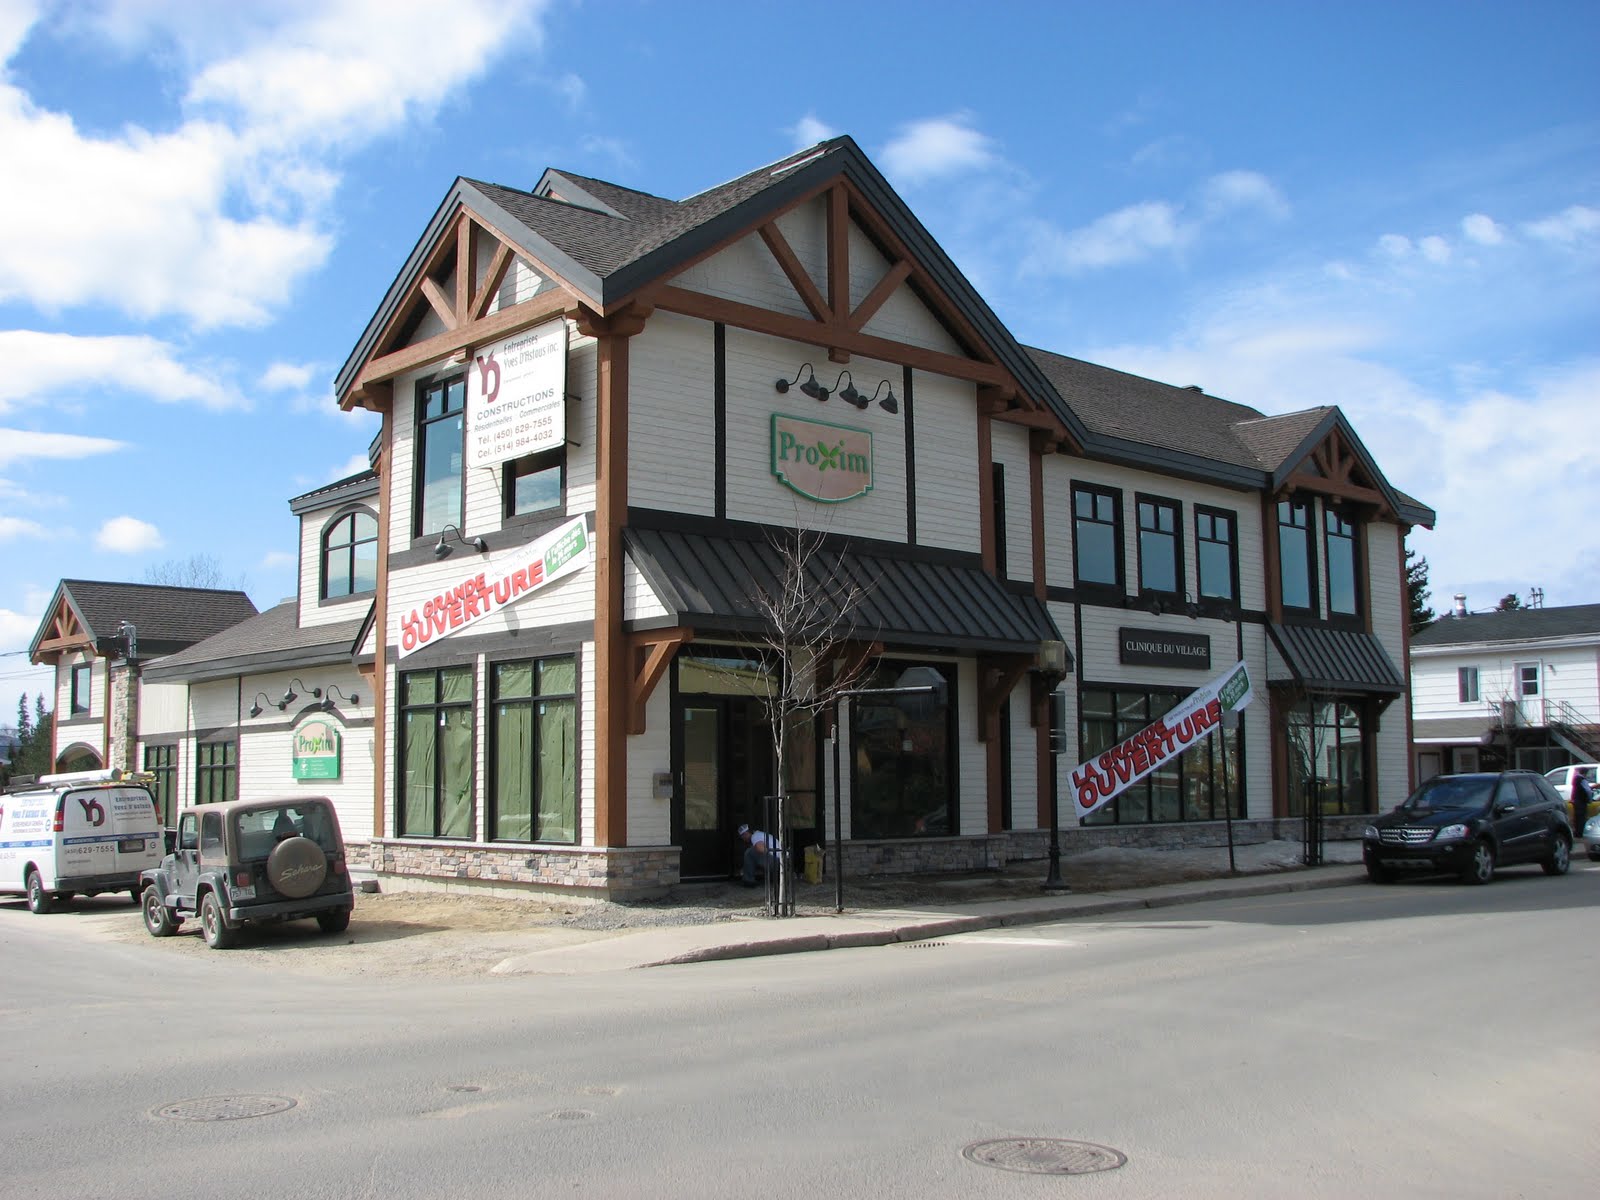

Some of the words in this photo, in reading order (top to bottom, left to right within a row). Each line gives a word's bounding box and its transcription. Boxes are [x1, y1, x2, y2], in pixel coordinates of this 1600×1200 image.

[503, 334, 538, 355] Entreprises
[503, 356, 518, 368] Yves
[547, 342, 559, 354] inc.
[477, 388, 554, 420] CONSTRUCTIONS
[519, 400, 561, 418] Commerciales
[493, 428, 513, 443] (450)
[515, 416, 553, 434] 629-7555
[494, 442, 513, 453] (514)
[515, 429, 553, 448] 984-4032
[779, 431, 868, 474] Proxim
[401, 609, 419, 631] LA
[423, 572, 486, 618] GRANDE
[402, 558, 544, 651] OUVERTURE
[1126, 640, 1162, 654] CLINIQUE
[1163, 644, 1174, 654] DU
[1175, 645, 1207, 656] VILLAGE
[298, 733, 335, 755] Proxim
[1072, 762, 1097, 789] LA
[1099, 718, 1167, 770] GRANDE
[1078, 698, 1222, 809] OUVERTURE
